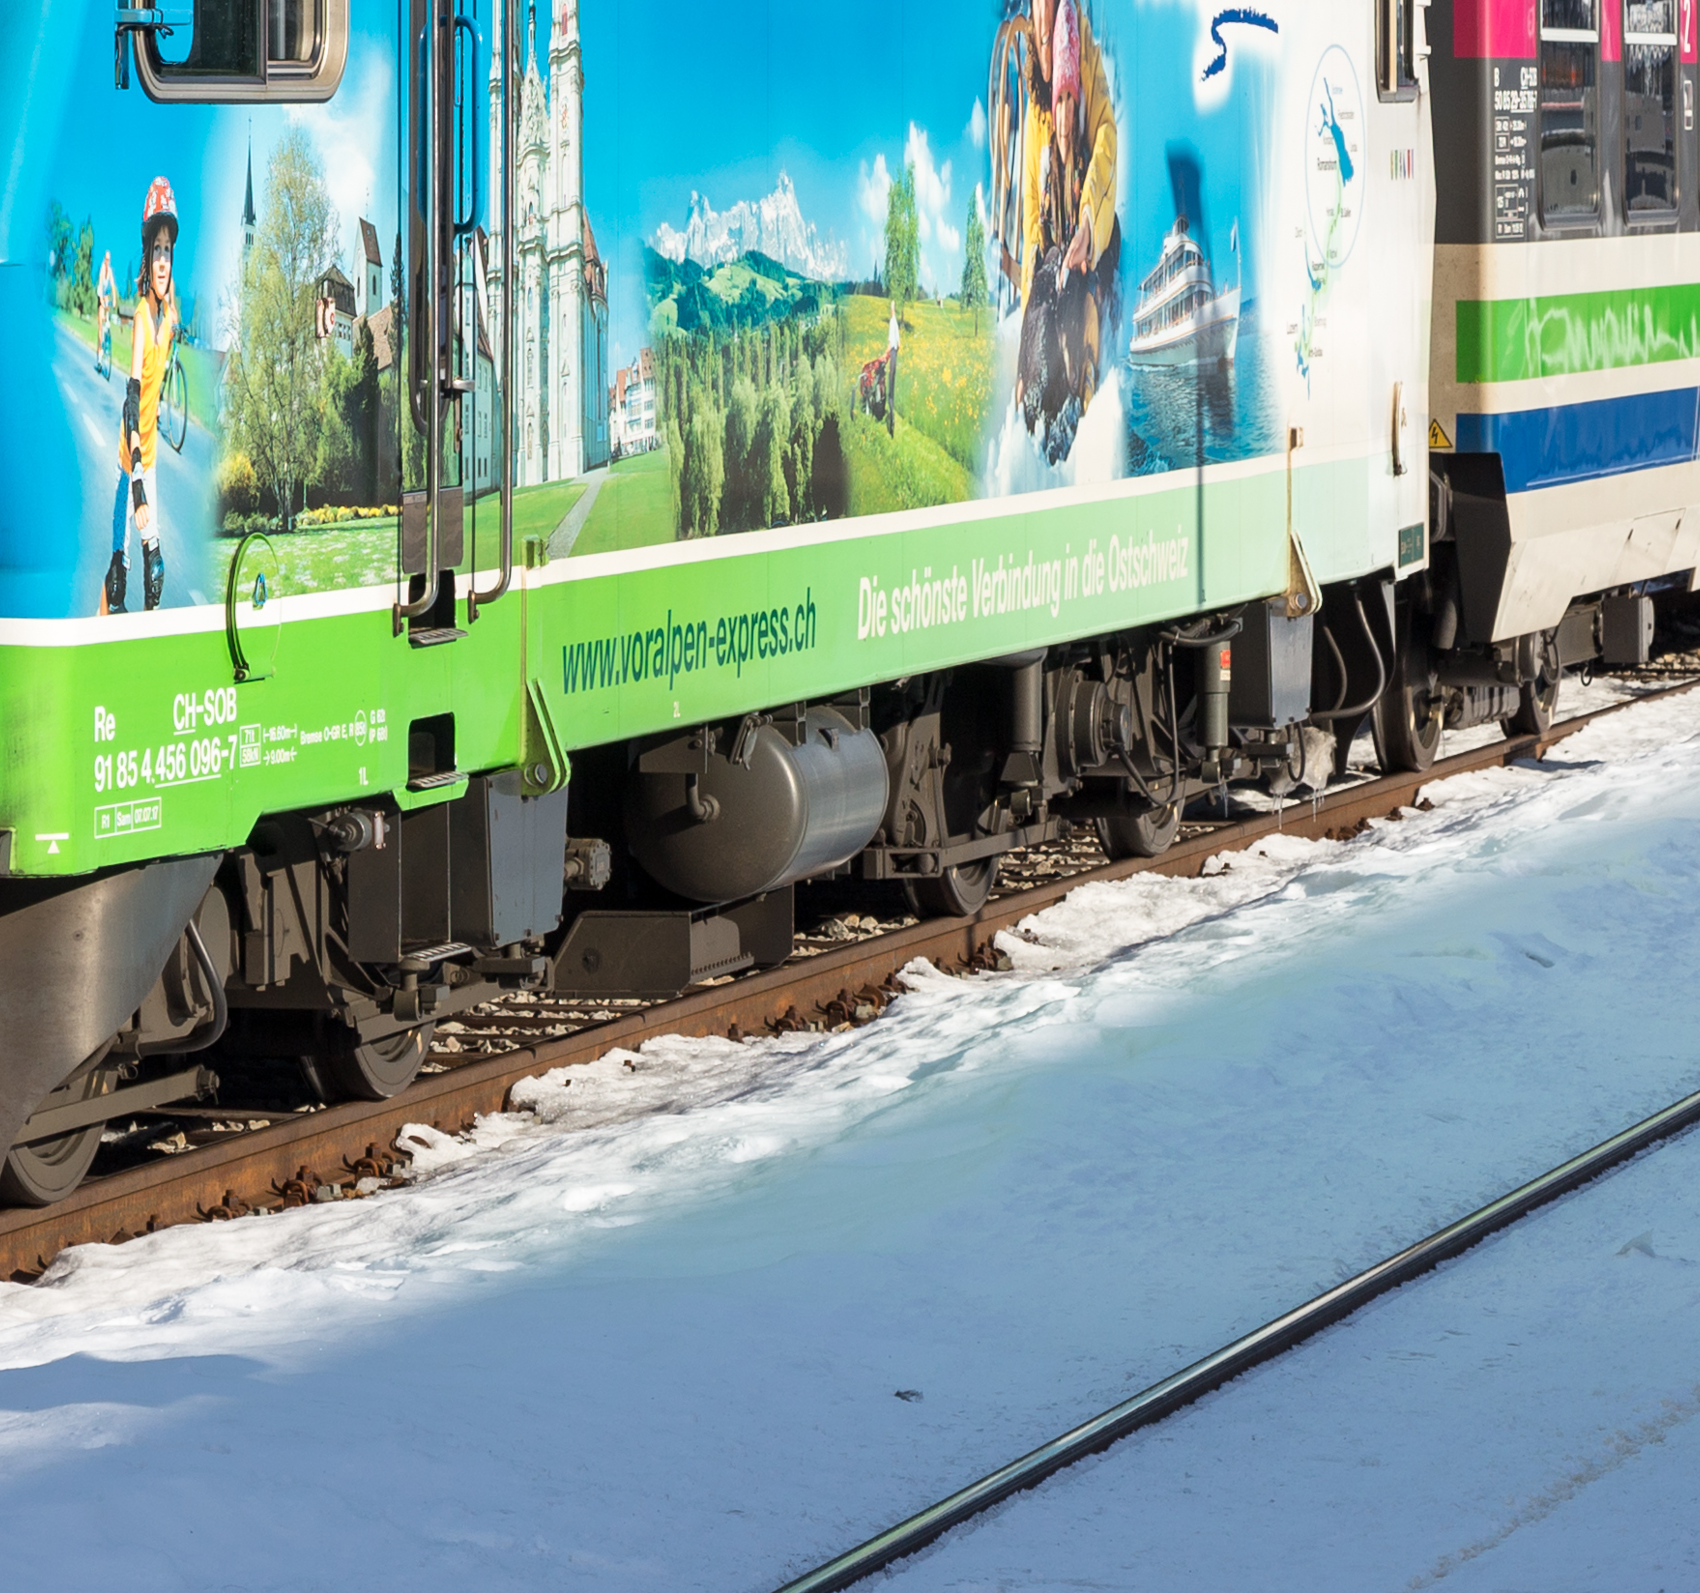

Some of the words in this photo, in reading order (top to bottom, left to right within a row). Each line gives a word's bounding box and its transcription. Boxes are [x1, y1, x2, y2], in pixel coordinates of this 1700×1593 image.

[857, 574, 887, 640] Die
[890, 564, 968, 635] schönste
[972, 549, 1061, 619] Verbindung
[1064, 543, 1078, 601] in
[1082, 538, 1105, 599] die
[1108, 523, 1189, 593] Ostschweiz
[562, 586, 816, 695] www.voralpen-express.ch
[94, 706, 116, 743] Re
[173, 687, 237, 732] CH-SOB
[94, 754, 113, 793] 91
[116, 750, 137, 789] 85
[189, 734, 238, 778] 096-7
[358, 767, 368, 785] 1L
[117, 811, 131, 827] Sam
